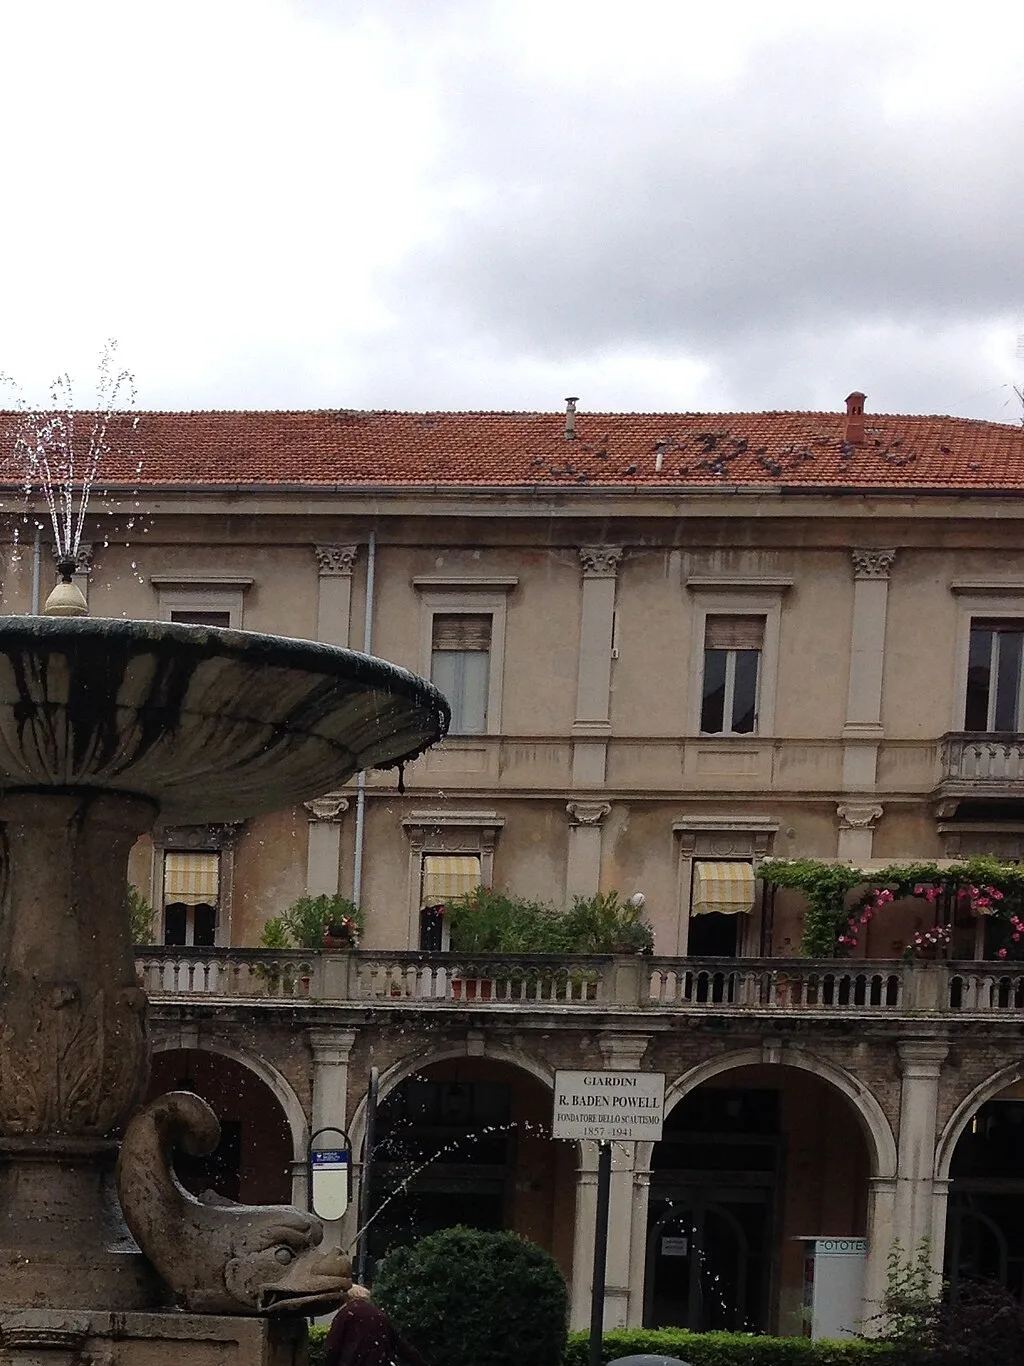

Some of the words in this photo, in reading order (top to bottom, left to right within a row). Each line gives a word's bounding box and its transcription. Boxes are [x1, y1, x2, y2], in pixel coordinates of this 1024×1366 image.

[583, 1076, 637, 1087] GIARDINI
[559, 1095, 569, 1106] R.
[572, 1095, 609, 1107] BADEN
[612, 1096, 660, 1108] POWELL
[557, 1113, 596, 1123] FONDATORE
[598, 1114, 621, 1124] DELLO
[621, 1115, 660, 1125] SCAUTISMO
[583, 1127, 605, 1136] 1857
[612, 1128, 632, 1137] 1941
